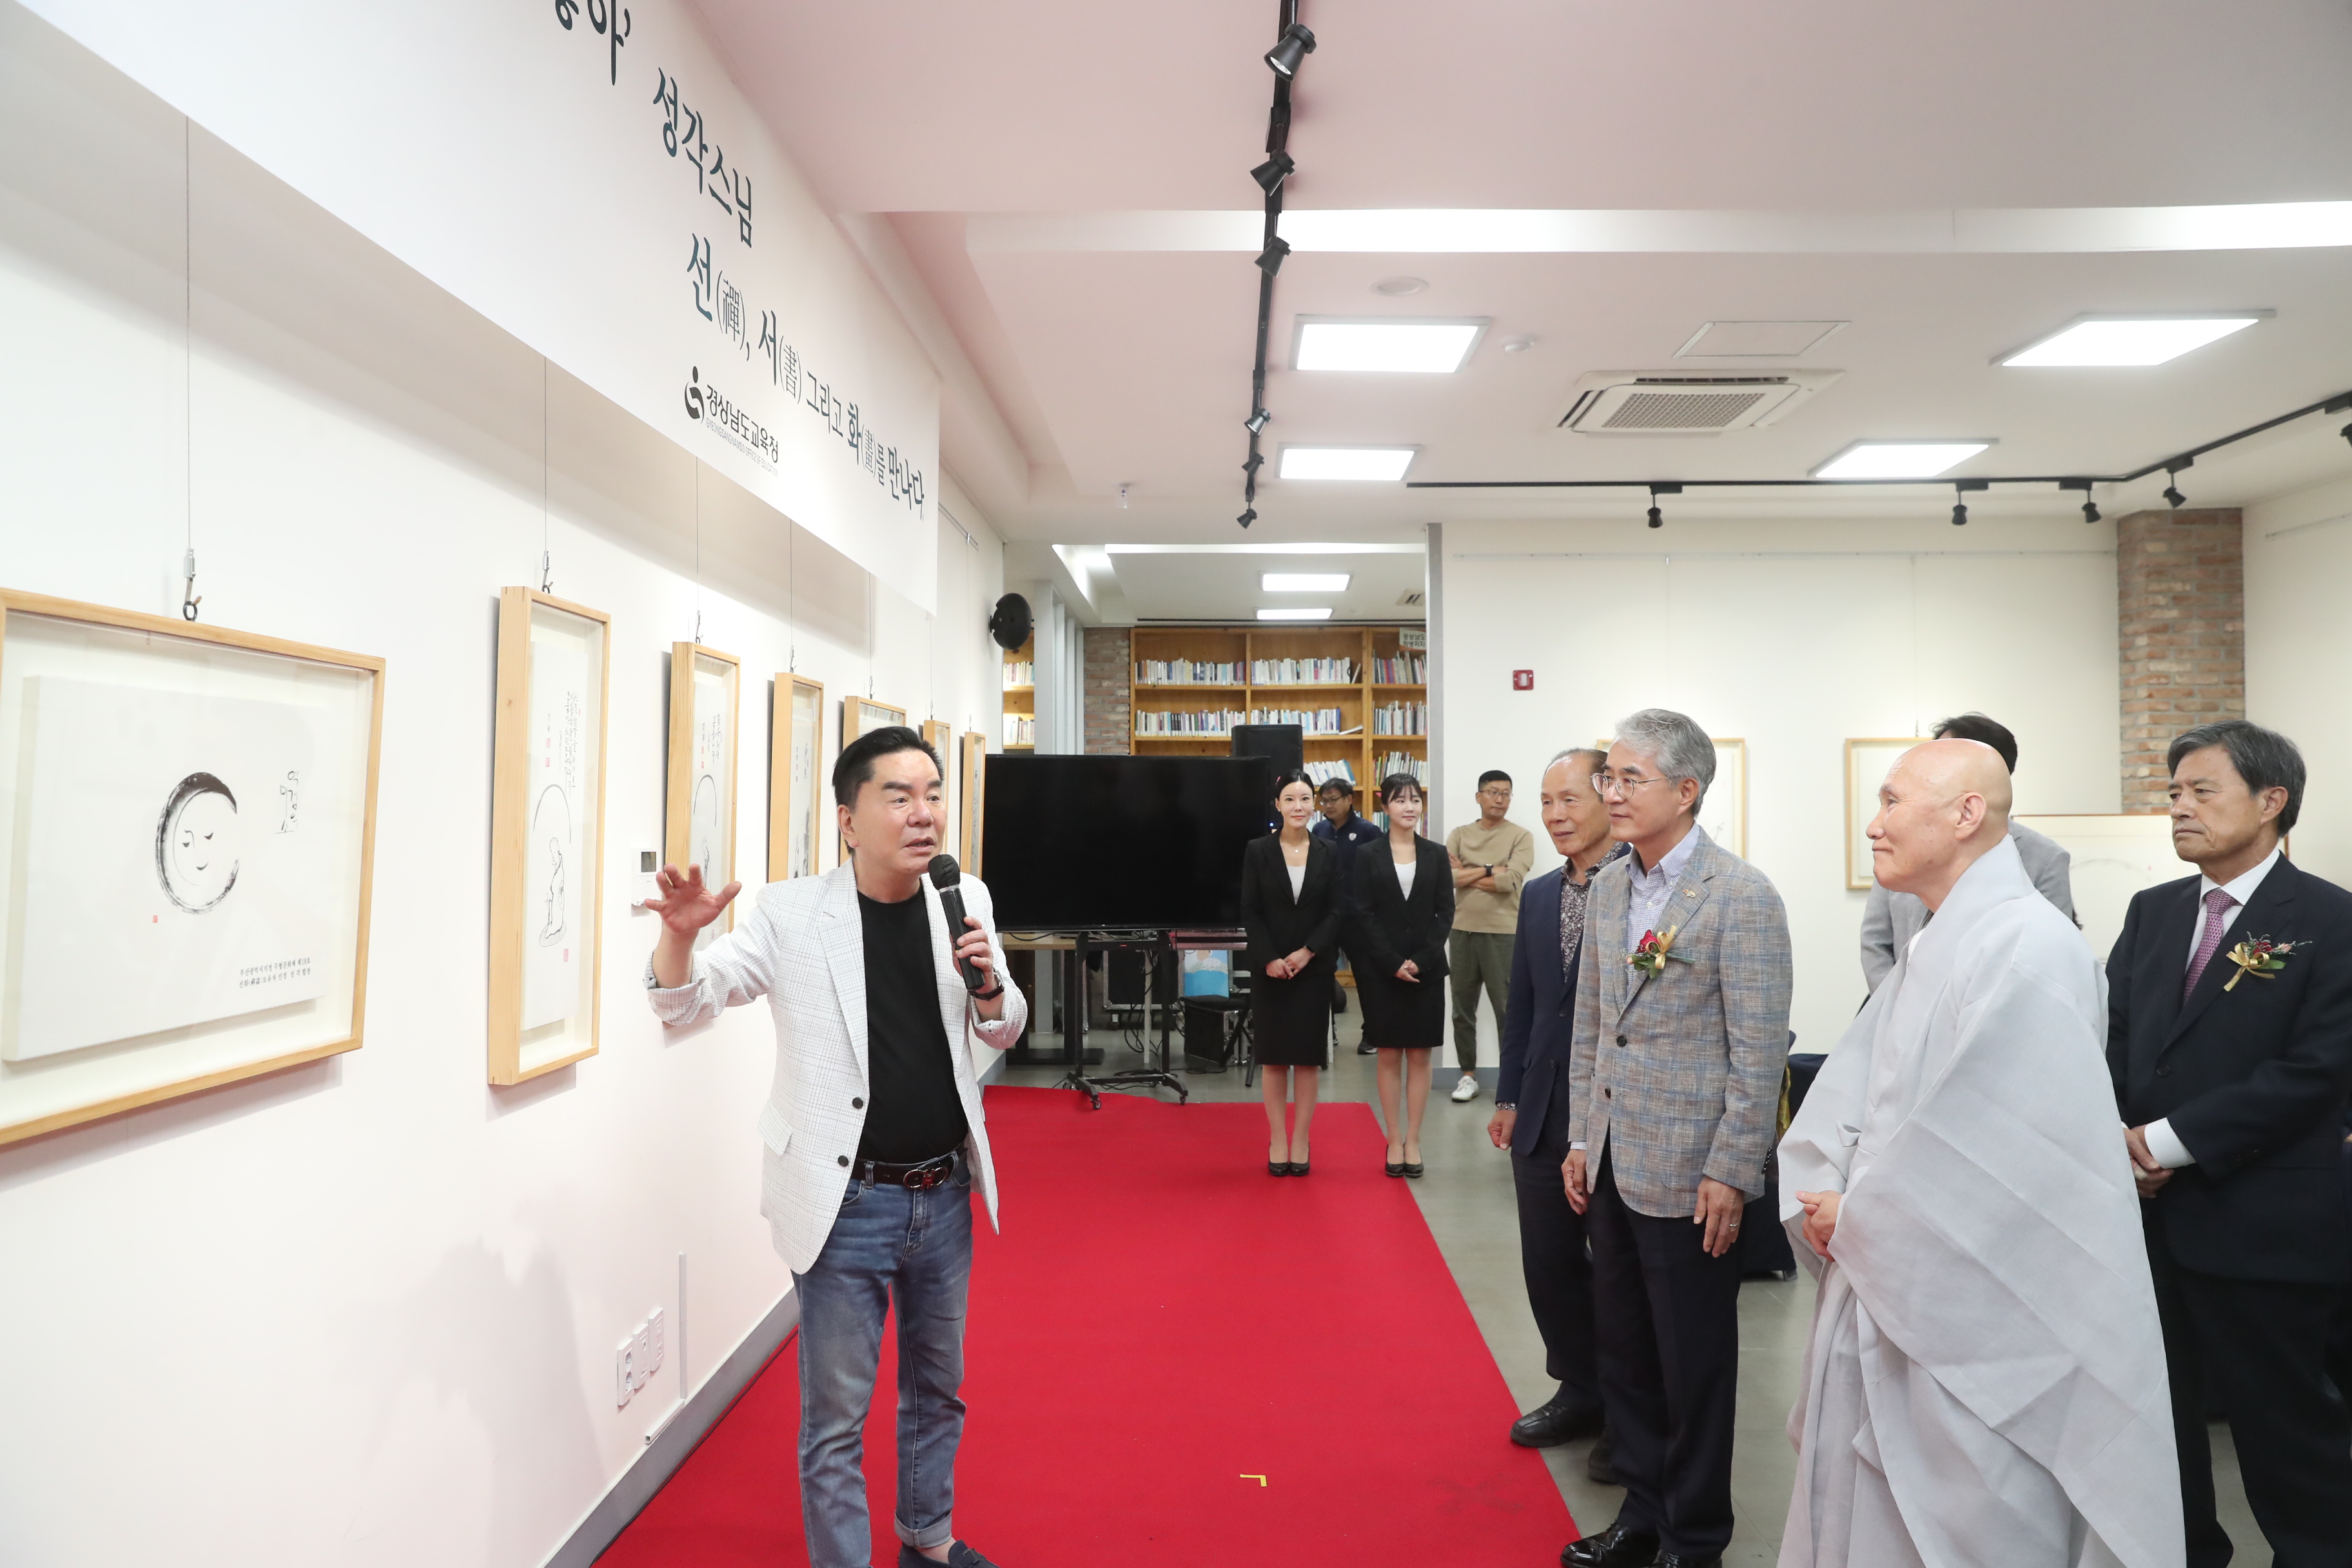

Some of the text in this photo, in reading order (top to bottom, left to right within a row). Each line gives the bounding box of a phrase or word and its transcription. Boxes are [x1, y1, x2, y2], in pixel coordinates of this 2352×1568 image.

[652, 67, 752, 248] 성각스님
[687, 232, 750, 362] 선(禪),
[758, 309, 801, 404] 서(書)
[806, 370, 843, 438] 그리고
[888, 446, 925, 521] 만나다
[706, 384, 778, 463] 경상남도교육청
[706, 416, 745, 453] GYEONGSANGNAMDO
[745, 446, 756, 462] OFFICE
[756, 454, 761, 465] OF
